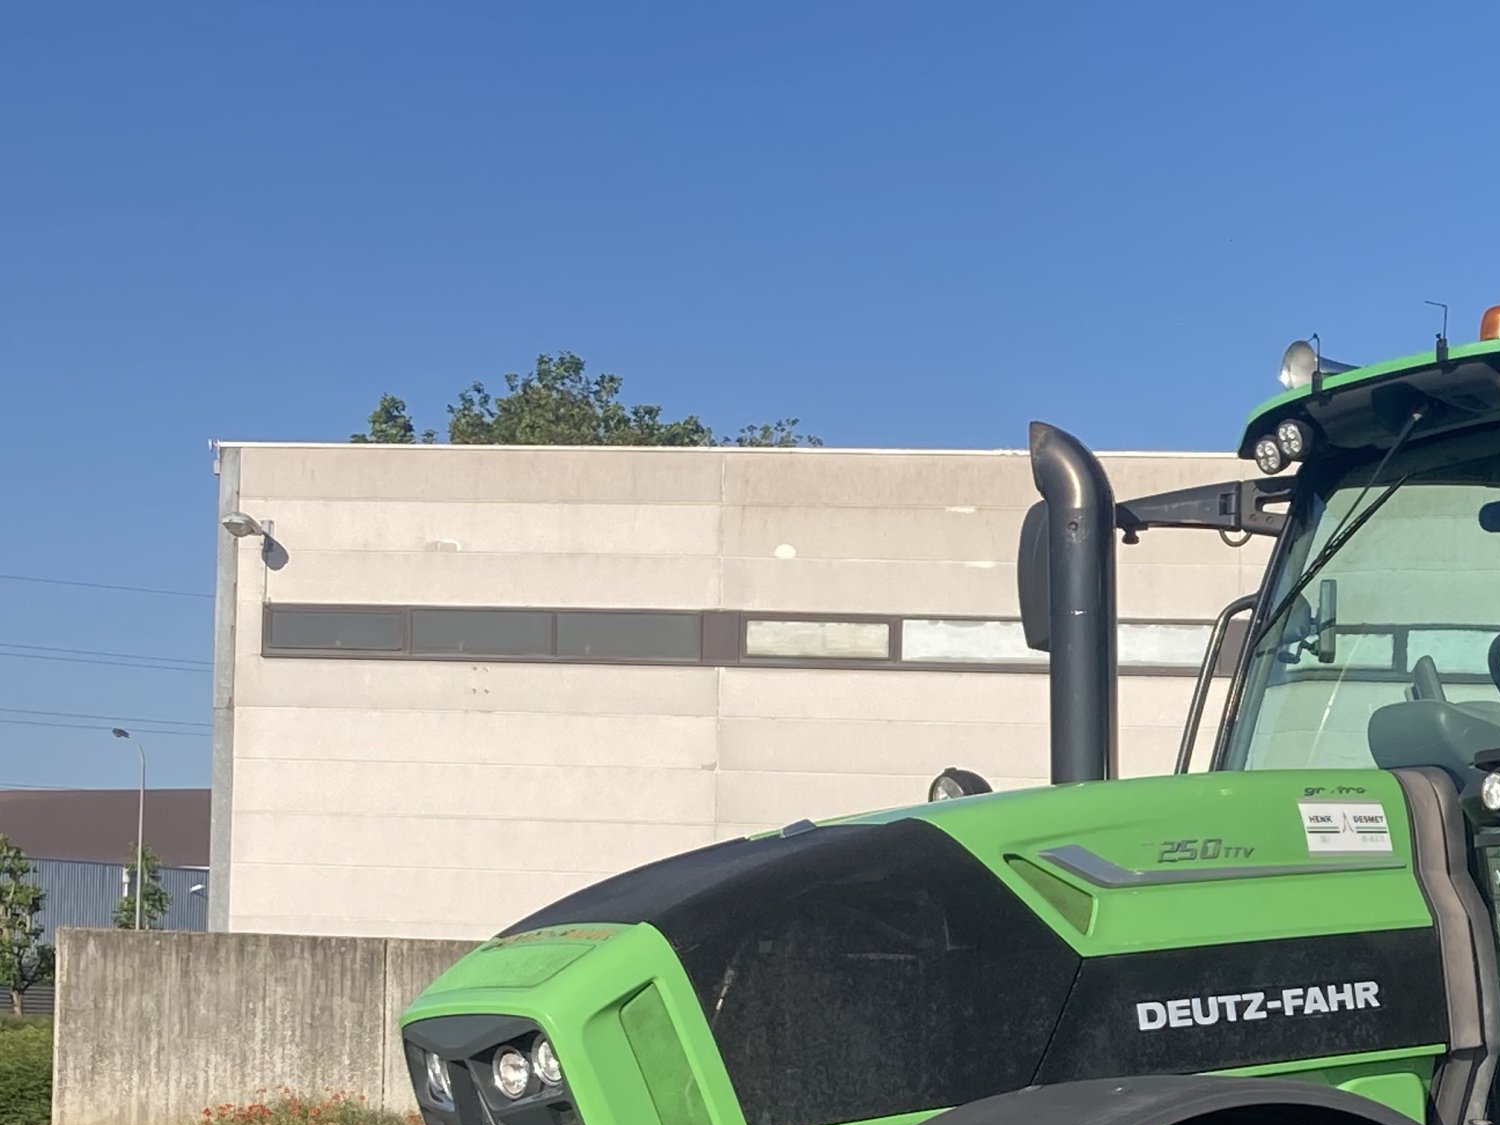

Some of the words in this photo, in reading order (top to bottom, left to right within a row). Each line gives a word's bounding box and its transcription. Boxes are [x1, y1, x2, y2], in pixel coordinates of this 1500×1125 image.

[1158, 839, 1222, 863] 250
[1224, 847, 1255, 858] TTV
[1136, 981, 1381, 1031] DEUTZ-FAHR
